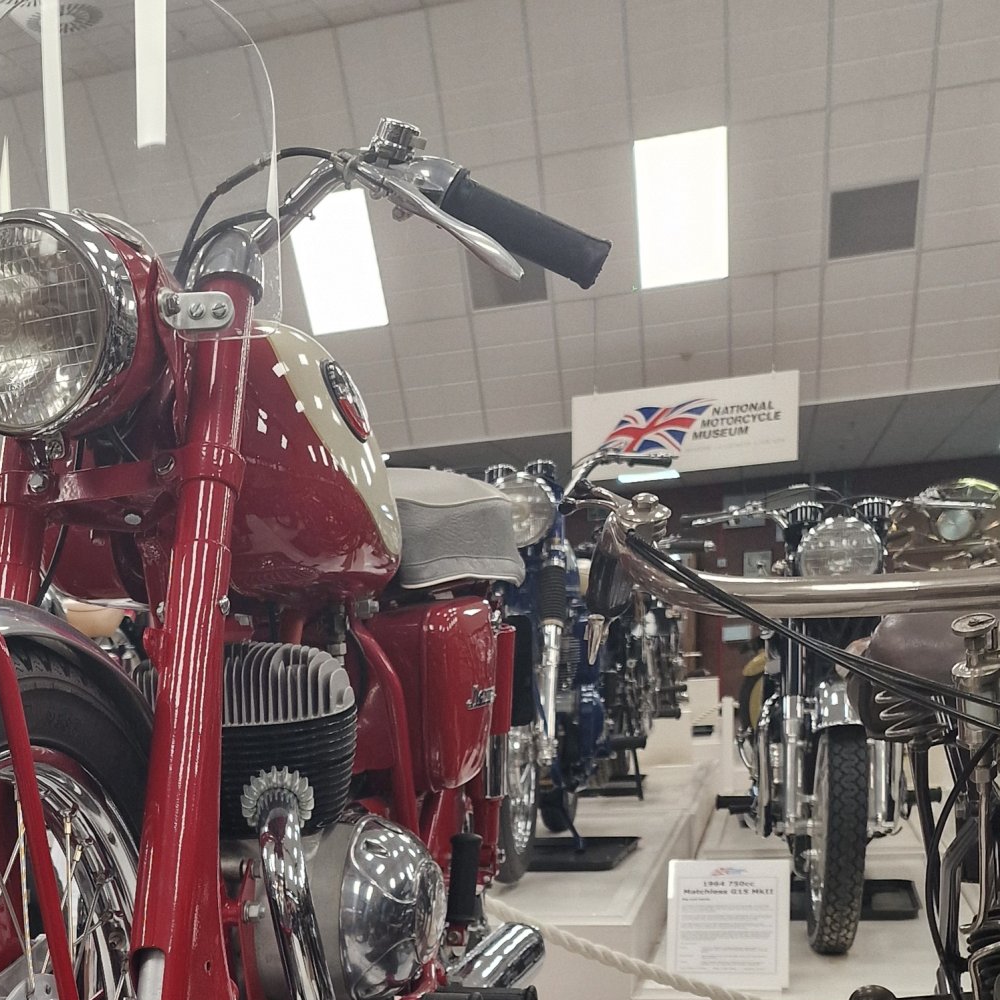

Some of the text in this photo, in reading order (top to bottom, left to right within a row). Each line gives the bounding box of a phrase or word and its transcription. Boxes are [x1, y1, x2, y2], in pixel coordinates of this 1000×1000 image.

[712, 401, 774, 416] NATIONAL
[700, 412, 781, 428] MOTORCYCLE
[692, 426, 749, 440] MUSEUM
